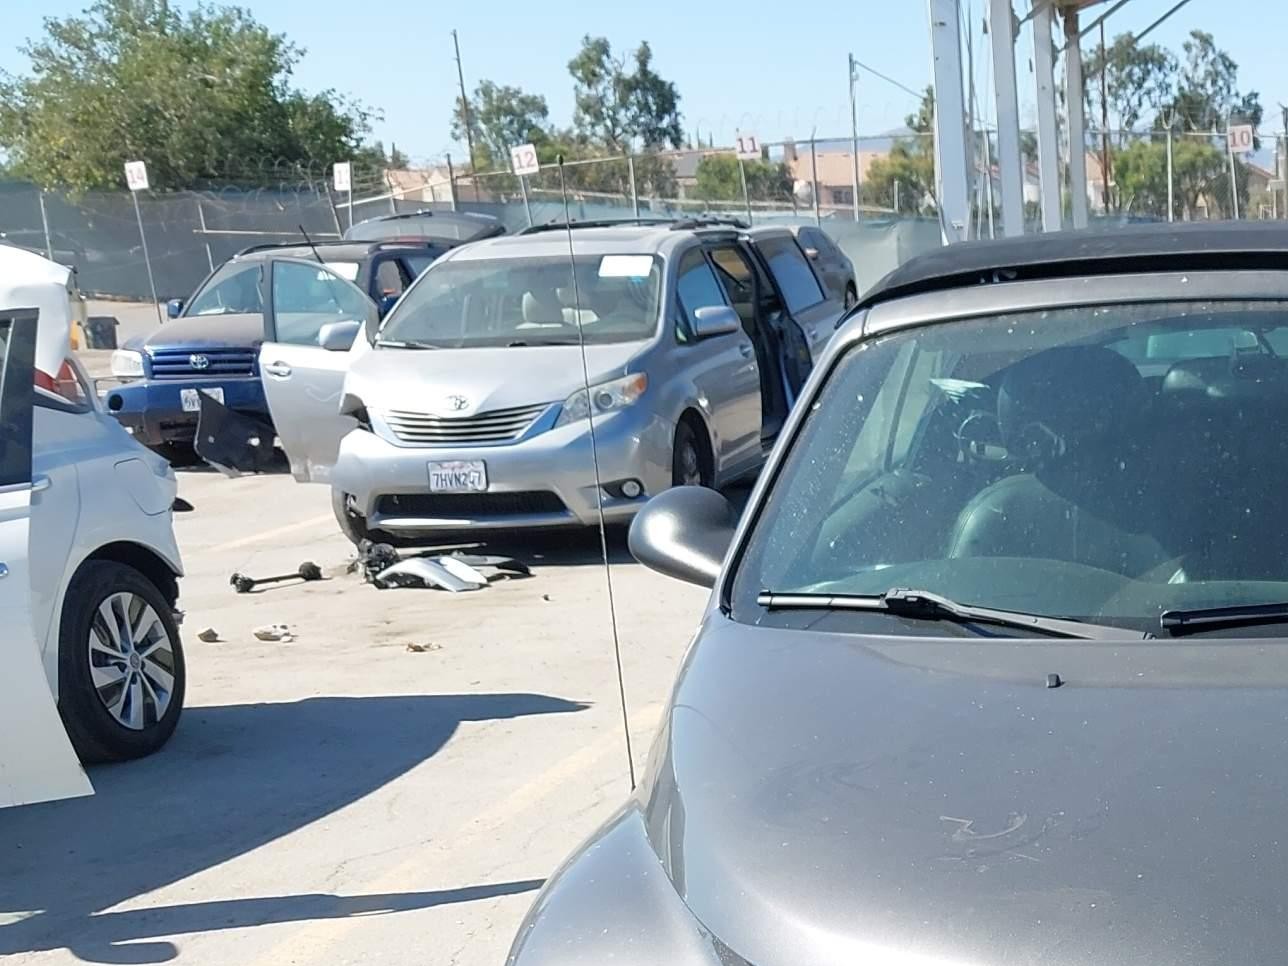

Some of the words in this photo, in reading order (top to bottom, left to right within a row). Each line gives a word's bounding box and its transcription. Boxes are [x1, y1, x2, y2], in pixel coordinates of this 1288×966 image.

[737, 136, 758, 153] 11
[1230, 130, 1250, 147] 10
[515, 151, 536, 169] 12
